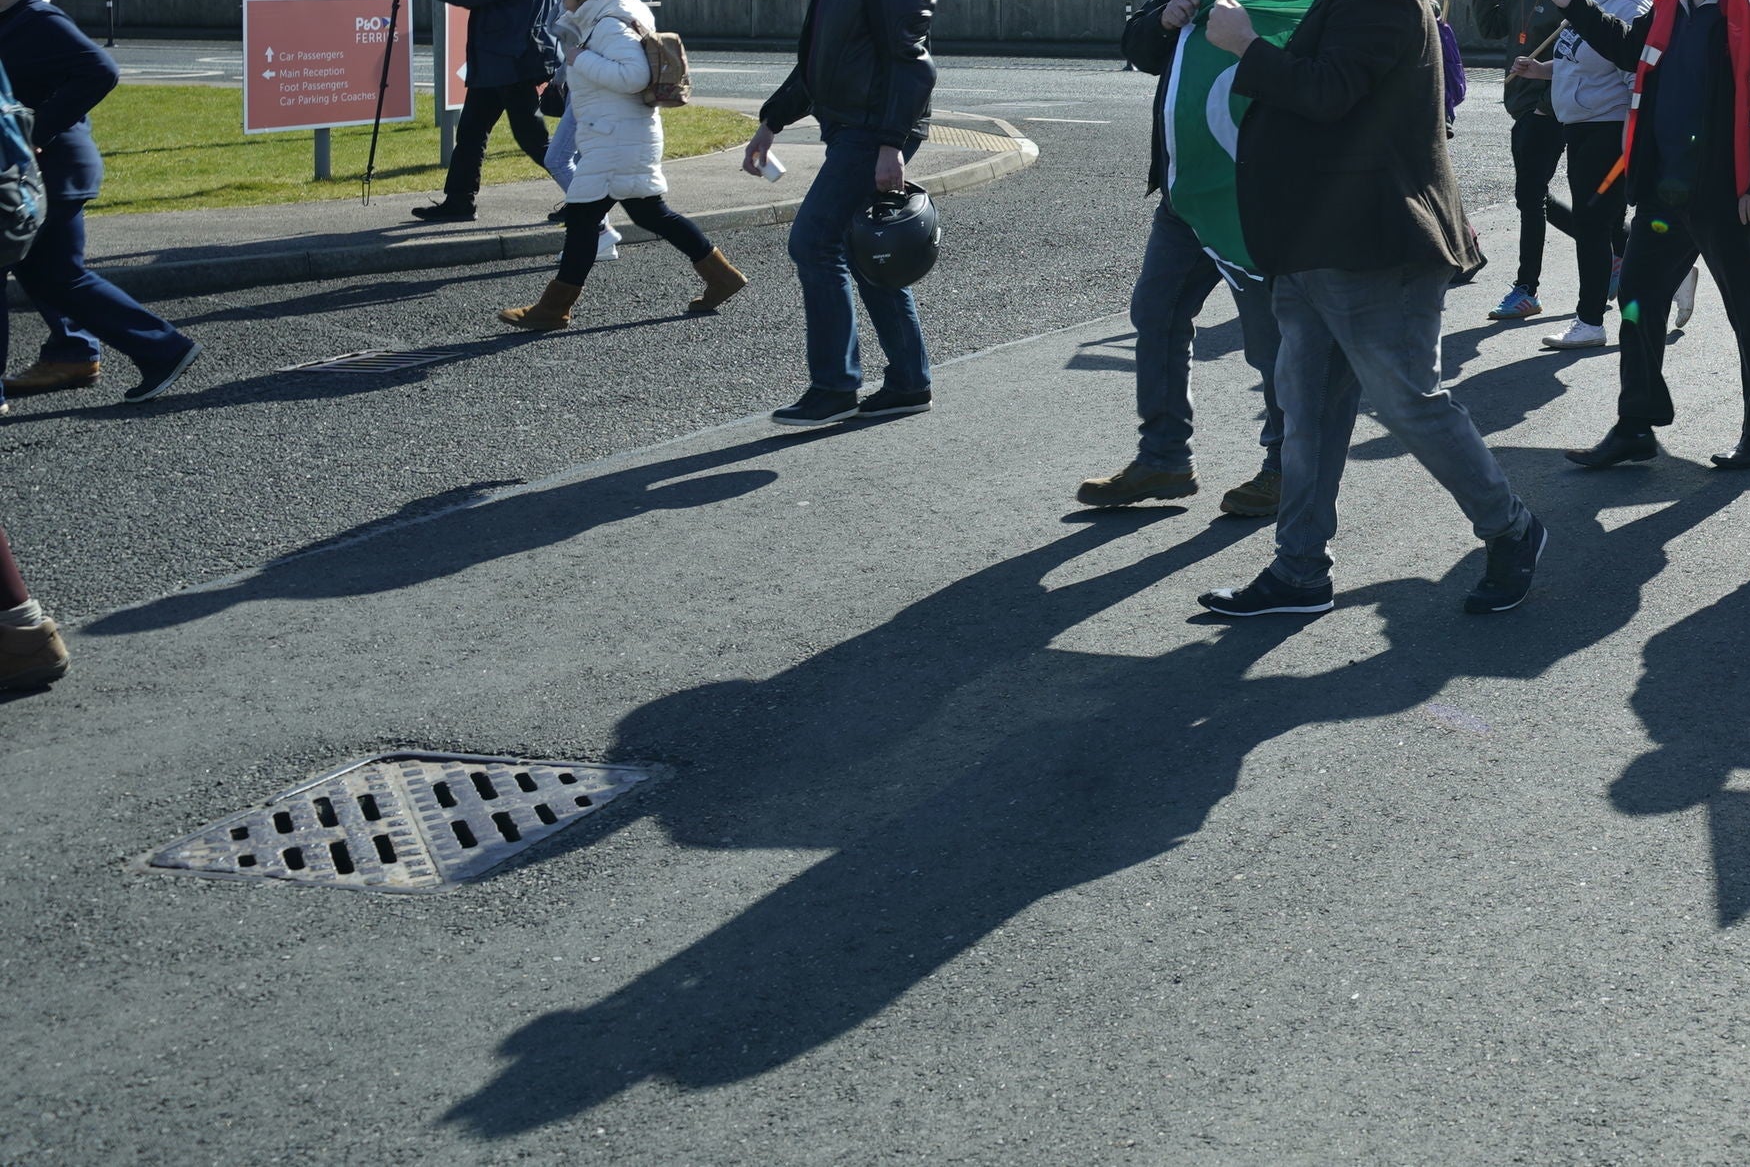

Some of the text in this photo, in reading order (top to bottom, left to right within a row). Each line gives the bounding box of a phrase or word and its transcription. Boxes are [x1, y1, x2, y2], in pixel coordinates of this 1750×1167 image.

[355, 17, 381, 31] P&O
[355, 31, 399, 44] FERRIS
[280, 50, 344, 61] Car Passengers
[280, 67, 345, 78] Main Reception
[280, 81, 349, 92] Foot Passengers
[280, 91, 376, 106] Car Parking & Coaches
